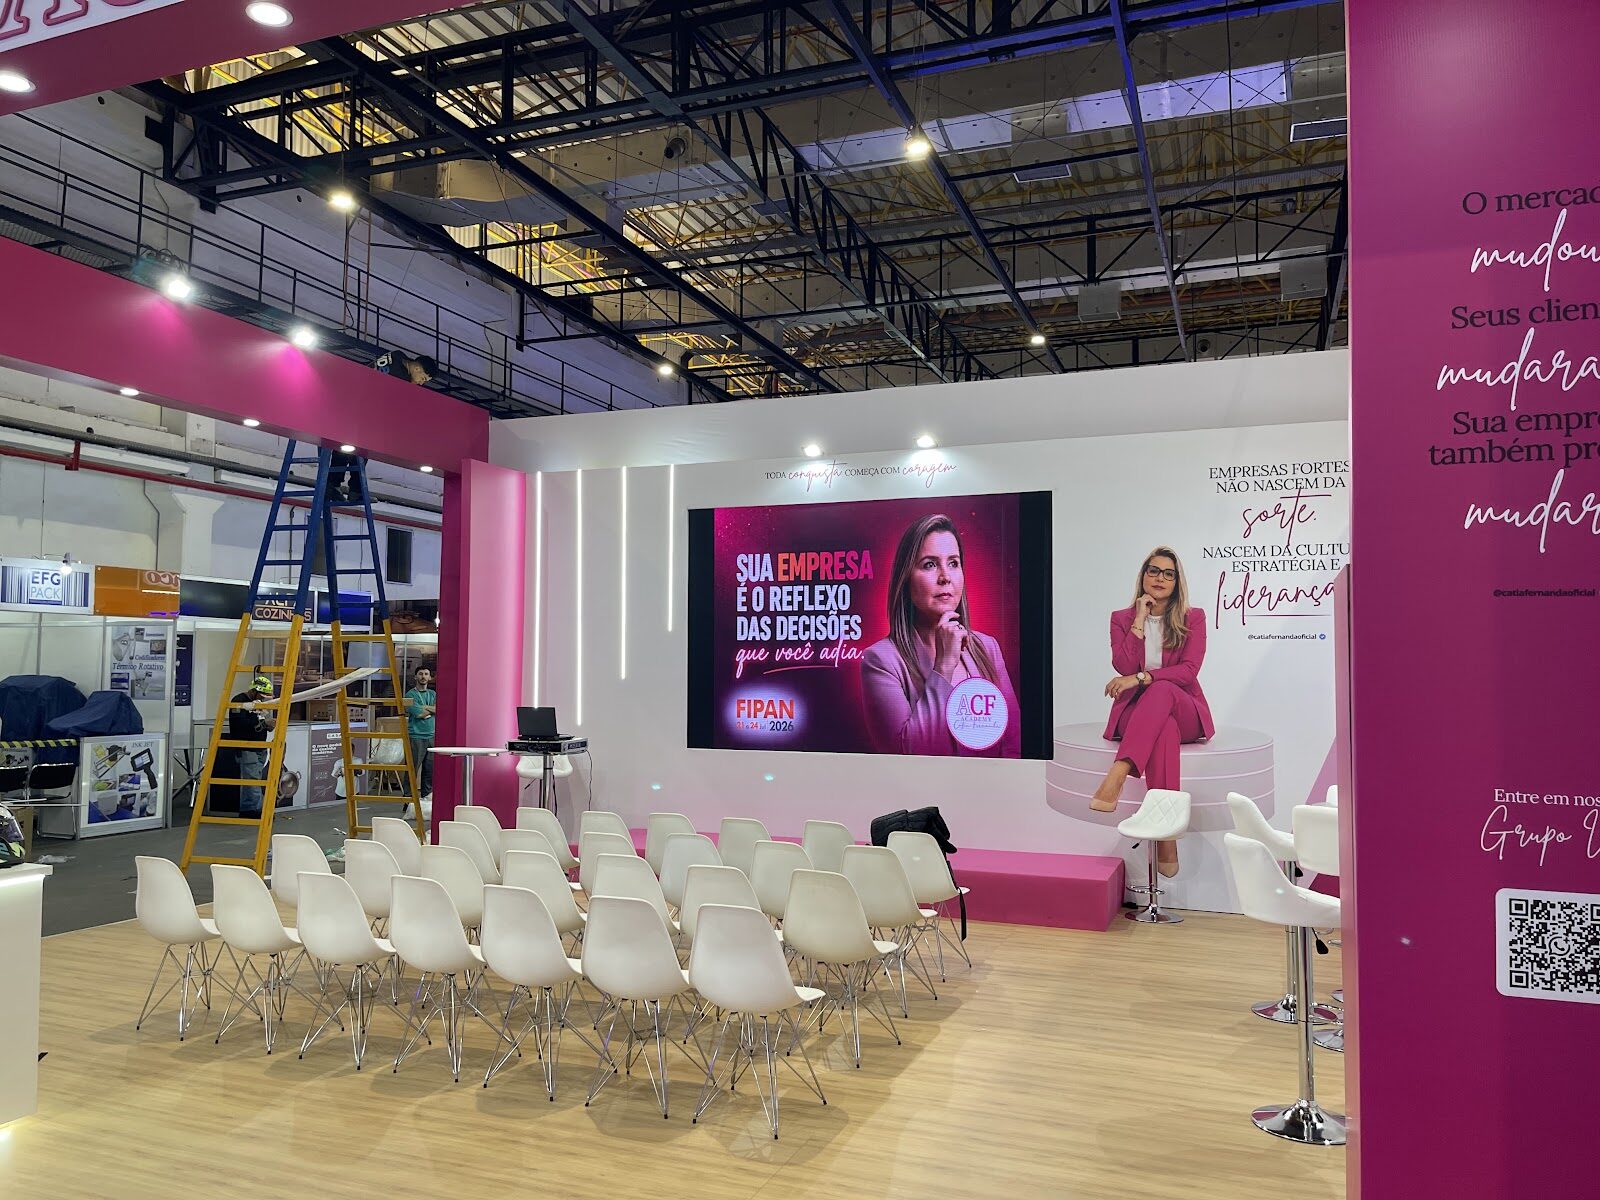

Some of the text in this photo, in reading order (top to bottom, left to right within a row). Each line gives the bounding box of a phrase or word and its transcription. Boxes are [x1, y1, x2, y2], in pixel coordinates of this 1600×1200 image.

[1462, 191, 1487, 215] O
[1470, 208, 1600, 292] mudou
[1451, 305, 1521, 329] Seus
[1436, 327, 1600, 411] mudara
[1453, 410, 1600, 438] Sua empr
[1428, 437, 1600, 468] também pr
[765, 459, 957, 492] TODA conquista COMEÇA COM coragem
[1209, 460, 1349, 480] EMPRESAS FORTES
[1216, 476, 1346, 494] NÃO NASCEM DA
[1463, 468, 1600, 553] mudar
[1202, 544, 1266, 559] NASCEM
[1271, 544, 1293, 557] DA
[736, 549, 874, 583] SUA EMPRESA
[1231, 557, 1341, 573] ESTRATÉGIA E
[31, 571, 61, 586] EFG
[30, 586, 60, 600] PACK
[736, 582, 850, 612] É O REFLEXO
[1216, 571, 1335, 630] liderança
[1493, 588, 1596, 598] @catiafernandaoficial
[255, 607, 312, 622] COZINS
[736, 609, 862, 641] DAS DECISÕES
[1247, 633, 1317, 641] @catiafernandaoficial
[138, 662, 164, 670] Rotativo
[735, 637, 865, 679] que você adia.
[736, 699, 795, 720] FIPAN
[955, 693, 997, 716] ACF
[769, 720, 795, 732] 2026
[1494, 788, 1540, 805] Entre
[1543, 794, 1570, 806] em
[1480, 804, 1573, 867] Grupo
